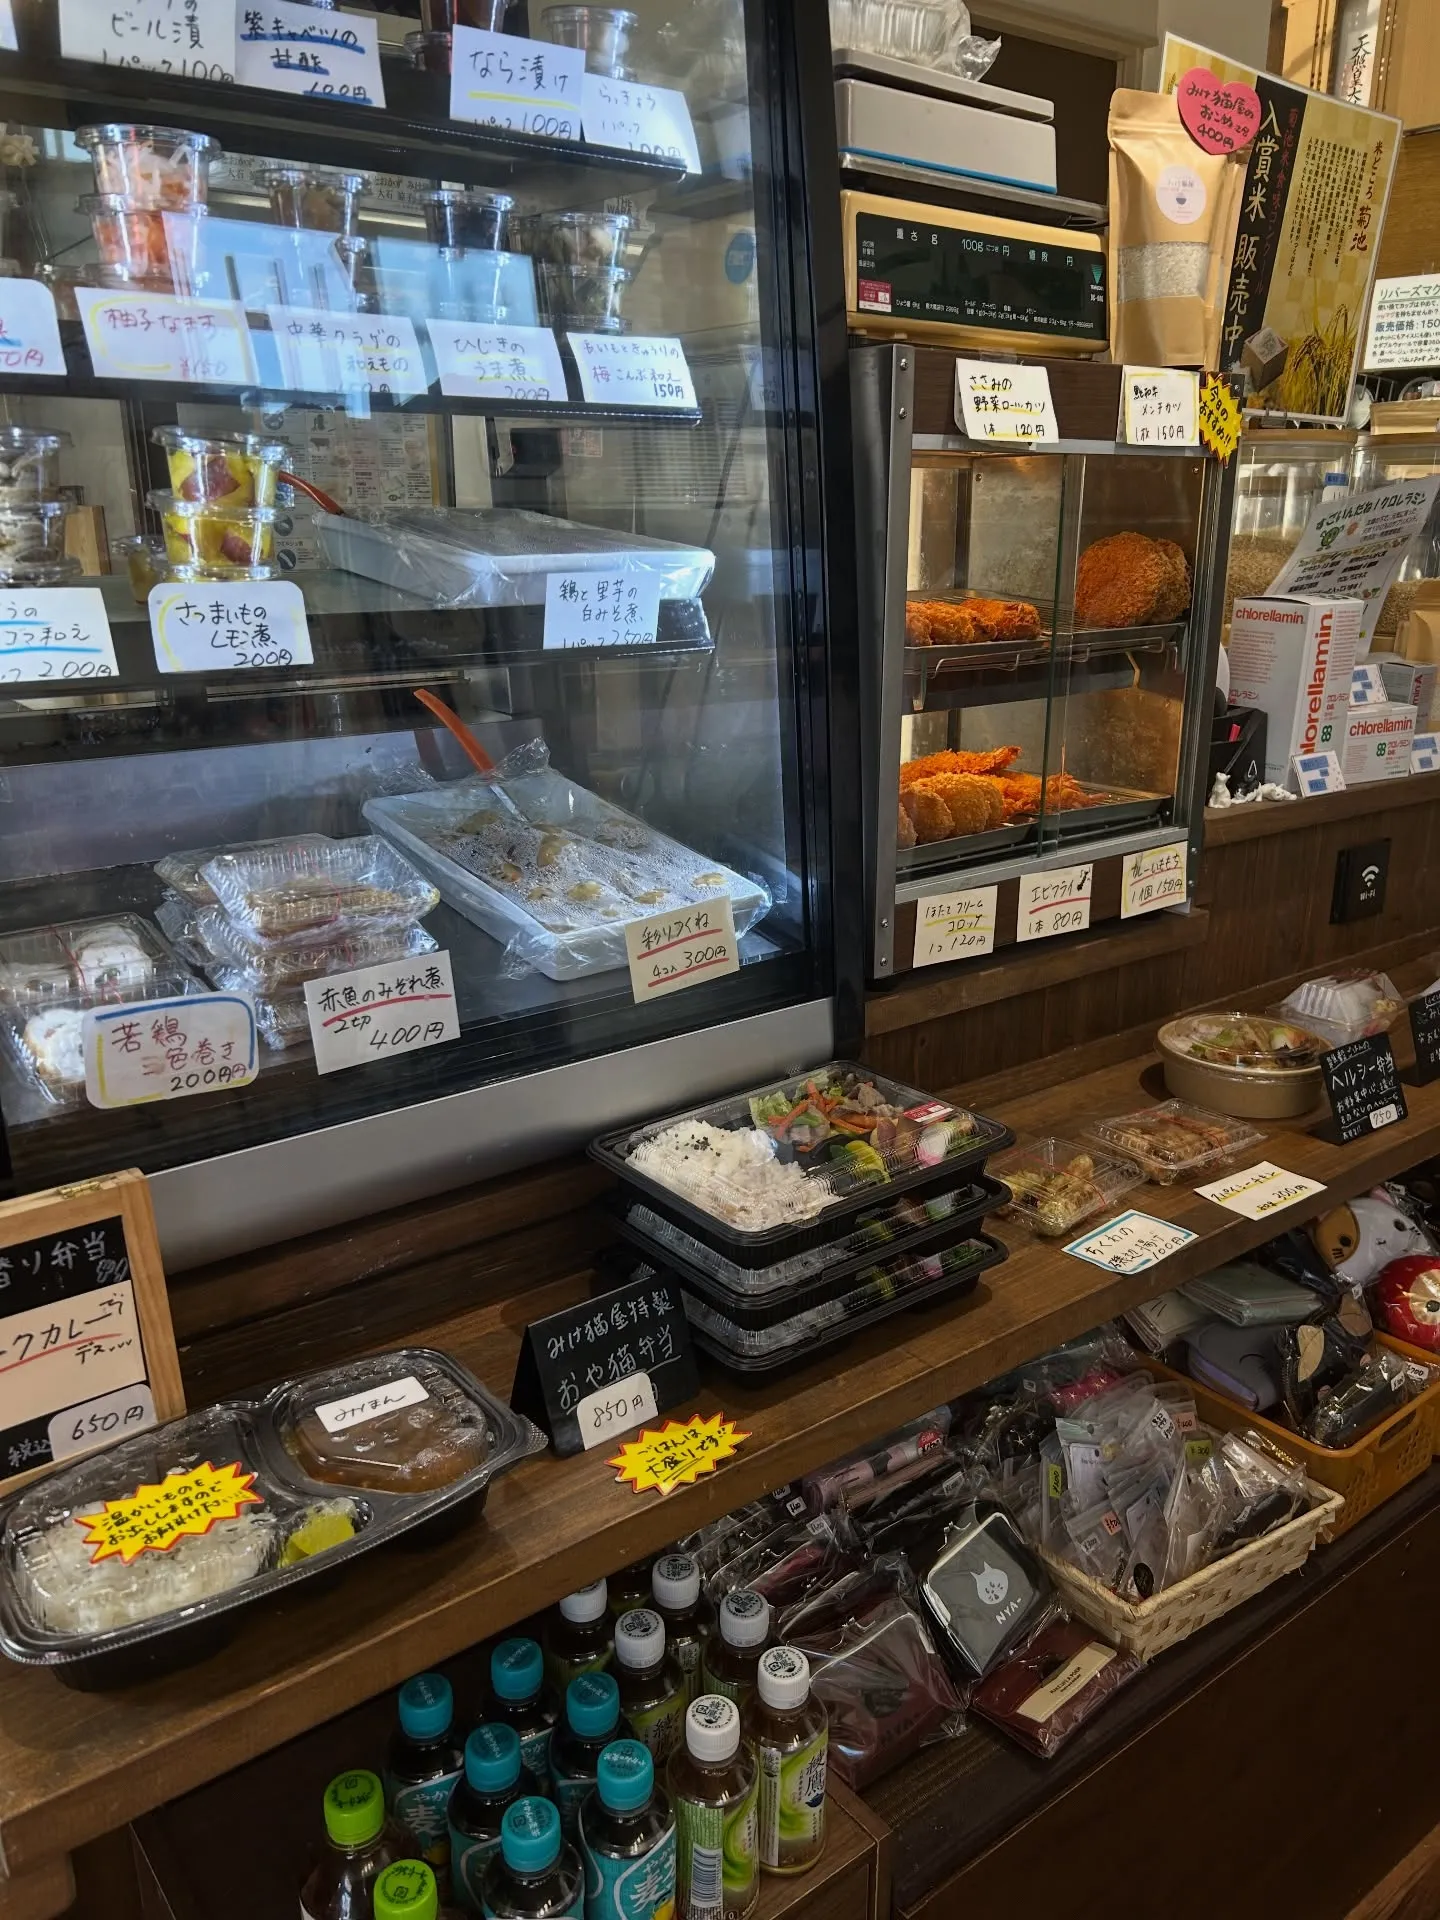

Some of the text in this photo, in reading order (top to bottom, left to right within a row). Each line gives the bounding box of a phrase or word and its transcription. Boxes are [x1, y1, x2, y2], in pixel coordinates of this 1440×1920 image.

[270, 50, 322, 68] 甘酢
[470, 50, 569, 92] なら漬け
[1197, 123, 1235, 149] 400円
[1223, 99, 1282, 357] 入賞米 販売中
[287, 321, 401, 349] 中華クラゲの
[452, 336, 526, 356] ひじきの
[476, 361, 537, 383] うま煮
[969, 375, 1013, 391] ささみの
[652, 382, 685, 400] 150円
[1209, 385, 1229, 422] 今日の
[1156, 425, 1185, 441] 150円
[558, 578, 638, 604] 鶏と里芋の
[174, 600, 268, 626] さつまいもの
[582, 603, 643, 624] 白みそ煮
[1234, 607, 1305, 625] chlorellamin
[210, 624, 279, 649] レモン煮
[37, 661, 113, 678] 200円
[233, 652, 294, 668] 200円
[1349, 717, 1413, 737] chlorellamin
[1031, 879, 1075, 903] エビフライ
[1156, 878, 1184, 895] 150円
[947, 914, 984, 934] コロッケ
[1052, 910, 1083, 932] 80円
[951, 935, 987, 951] 120円
[682, 945, 728, 969] 300円
[318, 967, 447, 1013] 赤魚のみぞれ煮
[111, 1015, 188, 1055] 若鶏
[333, 1015, 371, 1035] 2切
[368, 1021, 446, 1051] 400円
[1372, 1109, 1392, 1125] 750
[1084, 1226, 1134, 1256] ちくわの
[1152, 1236, 1186, 1260] 100円
[547, 1287, 675, 1360] みけ猫屋特製
[557, 1323, 674, 1410] おや猫弁当
[71, 1405, 145, 1441] 650円
[593, 1394, 645, 1428] 850円
[637, 1428, 702, 1464] ごはんは
